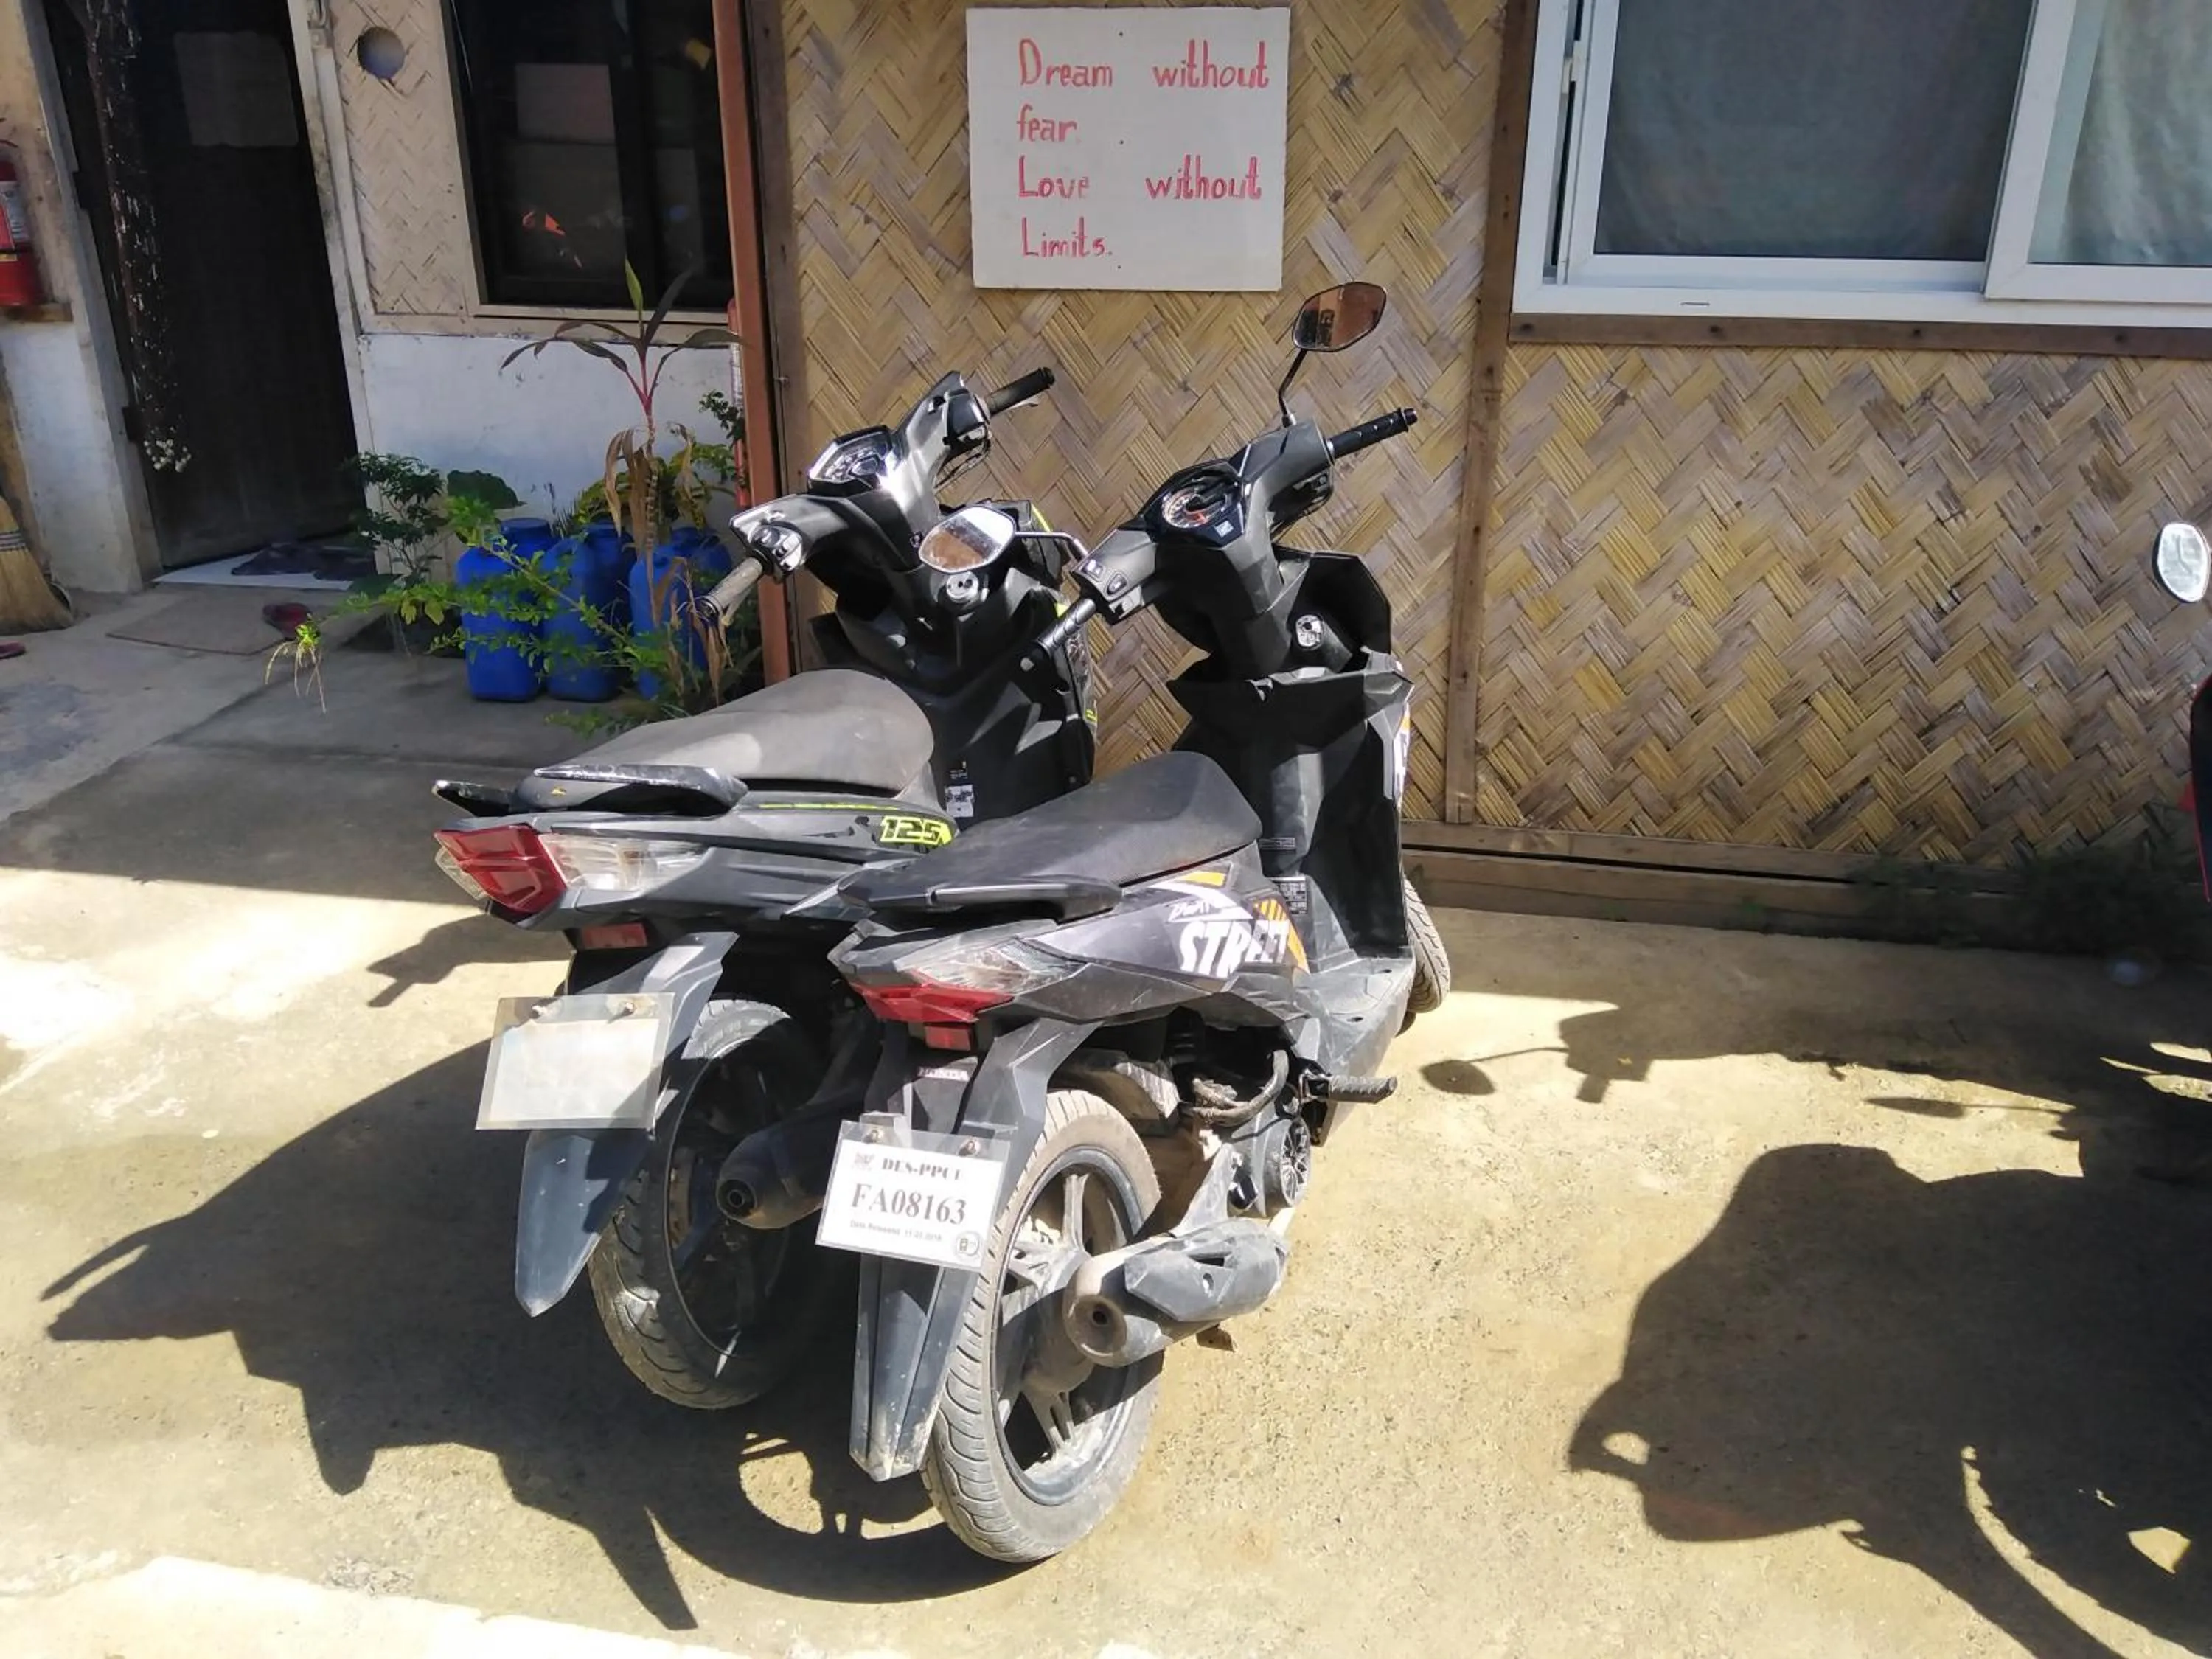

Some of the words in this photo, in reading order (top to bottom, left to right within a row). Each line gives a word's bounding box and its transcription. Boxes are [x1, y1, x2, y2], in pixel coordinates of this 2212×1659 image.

[1019, 38, 1113, 88] Dream
[1152, 38, 1270, 88] without
[1018, 154, 1090, 199] Love
[1145, 154, 1262, 199] without
[1021, 216, 1113, 257] Limits.
[881, 815, 942, 845] 125
[1179, 919, 1290, 979] STREET
[850, 1183, 967, 1225] FA08163
